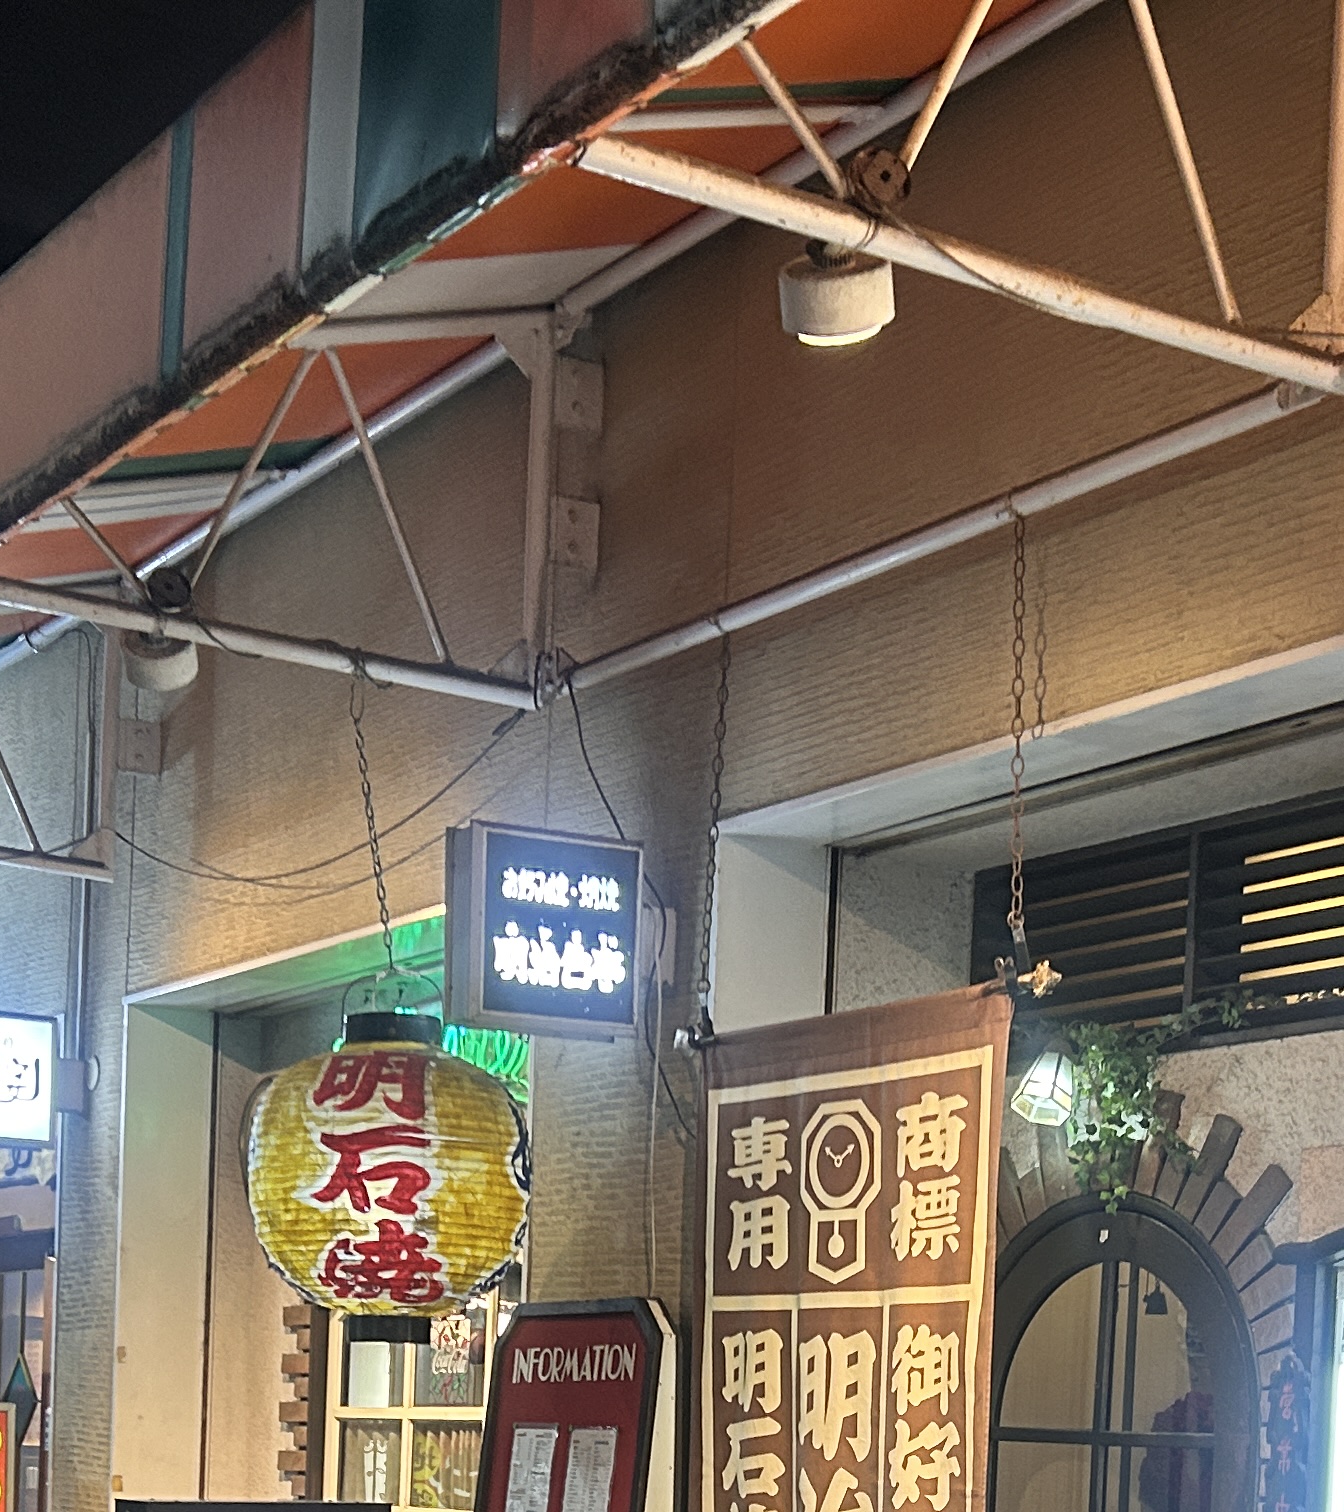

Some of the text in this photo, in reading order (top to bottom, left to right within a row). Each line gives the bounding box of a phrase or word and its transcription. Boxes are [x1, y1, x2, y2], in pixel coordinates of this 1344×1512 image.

[312, 1051, 445, 1304] 明石焼
[727, 1116, 792, 1271] 専用
[890, 1091, 968, 1262] 商標
[512, 1343, 637, 1384] INFORMATION
